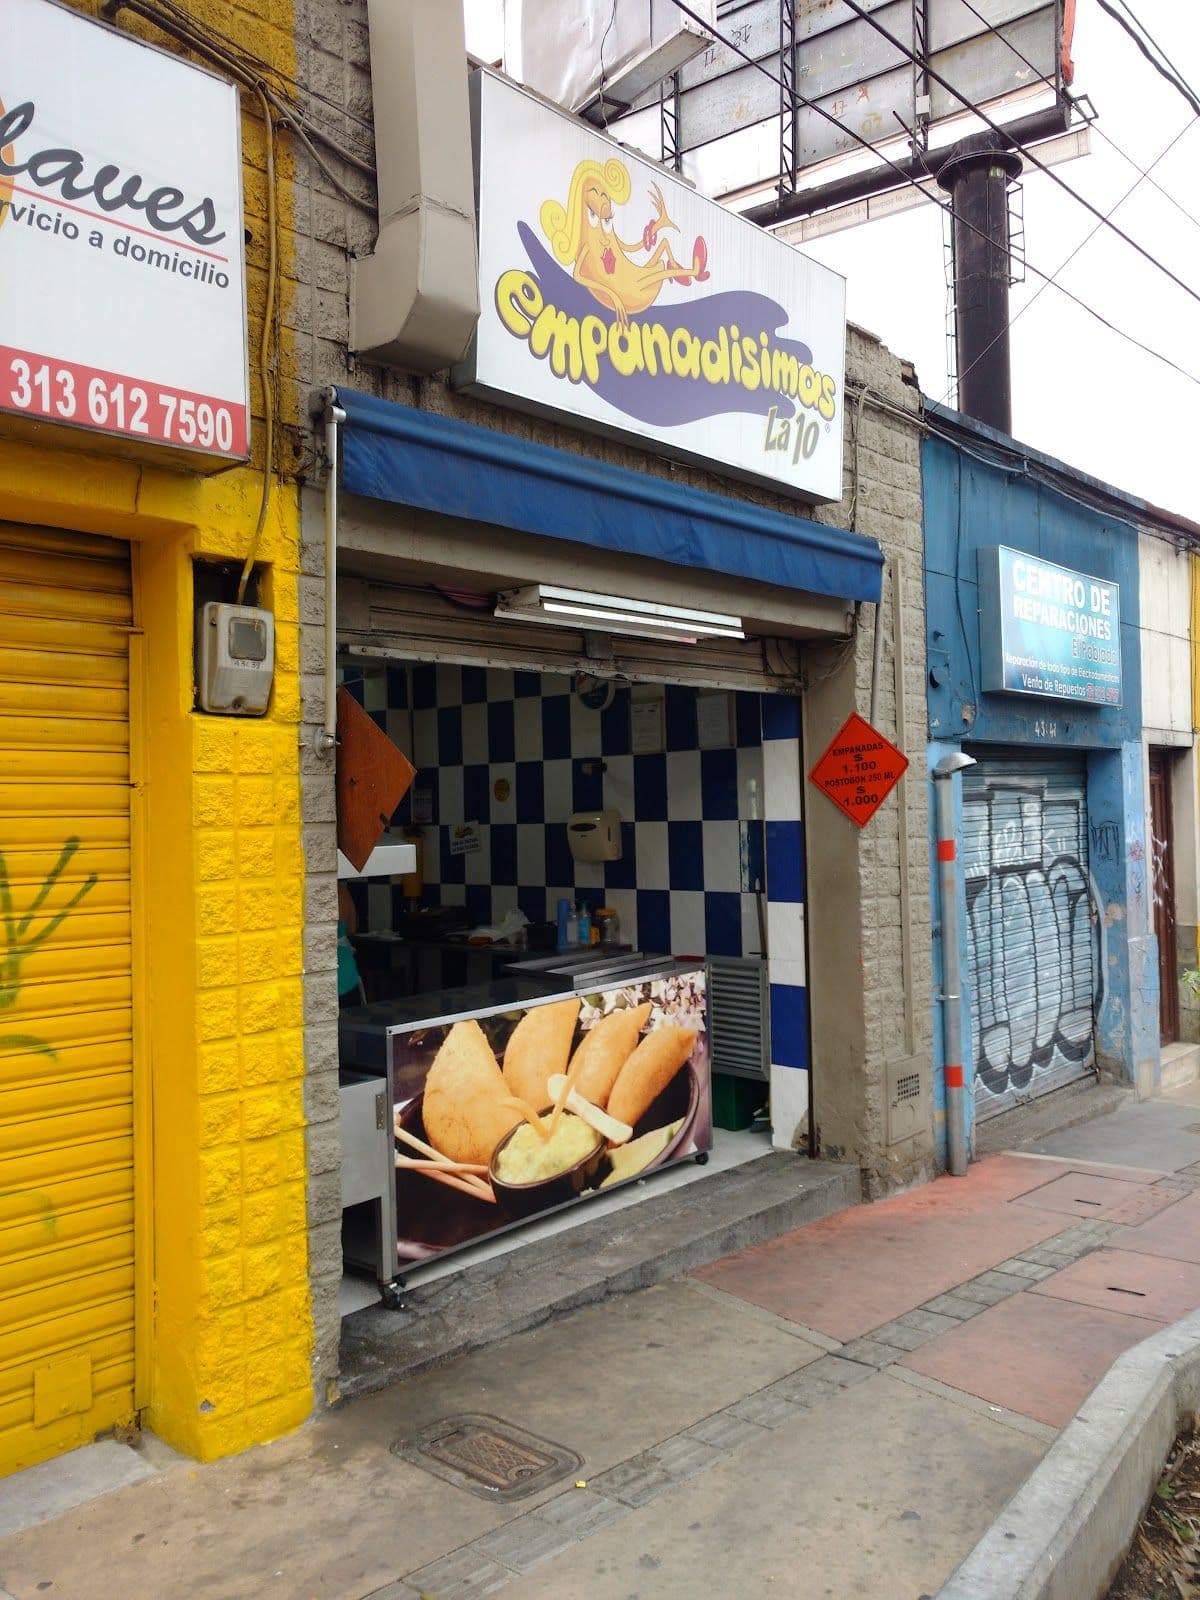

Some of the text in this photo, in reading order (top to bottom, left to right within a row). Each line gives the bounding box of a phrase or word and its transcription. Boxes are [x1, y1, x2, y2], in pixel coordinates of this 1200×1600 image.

[88, 229, 104, 248] a
[113, 235, 230, 289] domicilio
[9, 358, 233, 451] 313 612 7590
[764, 405, 820, 466] La 10
[1012, 559, 1111, 616] CENTRO DE
[1012, 596, 1112, 641] REPARACIONES
[1022, 673, 1043, 689] Venta
[1044, 678, 1053, 690] de
[1054, 679, 1086, 697] Repuestos
[832, 743, 884, 755] EMPANADAS
[842, 761, 877, 773] 1.100
[884, 771, 896, 780] ML
[843, 794, 879, 807] 1.000
